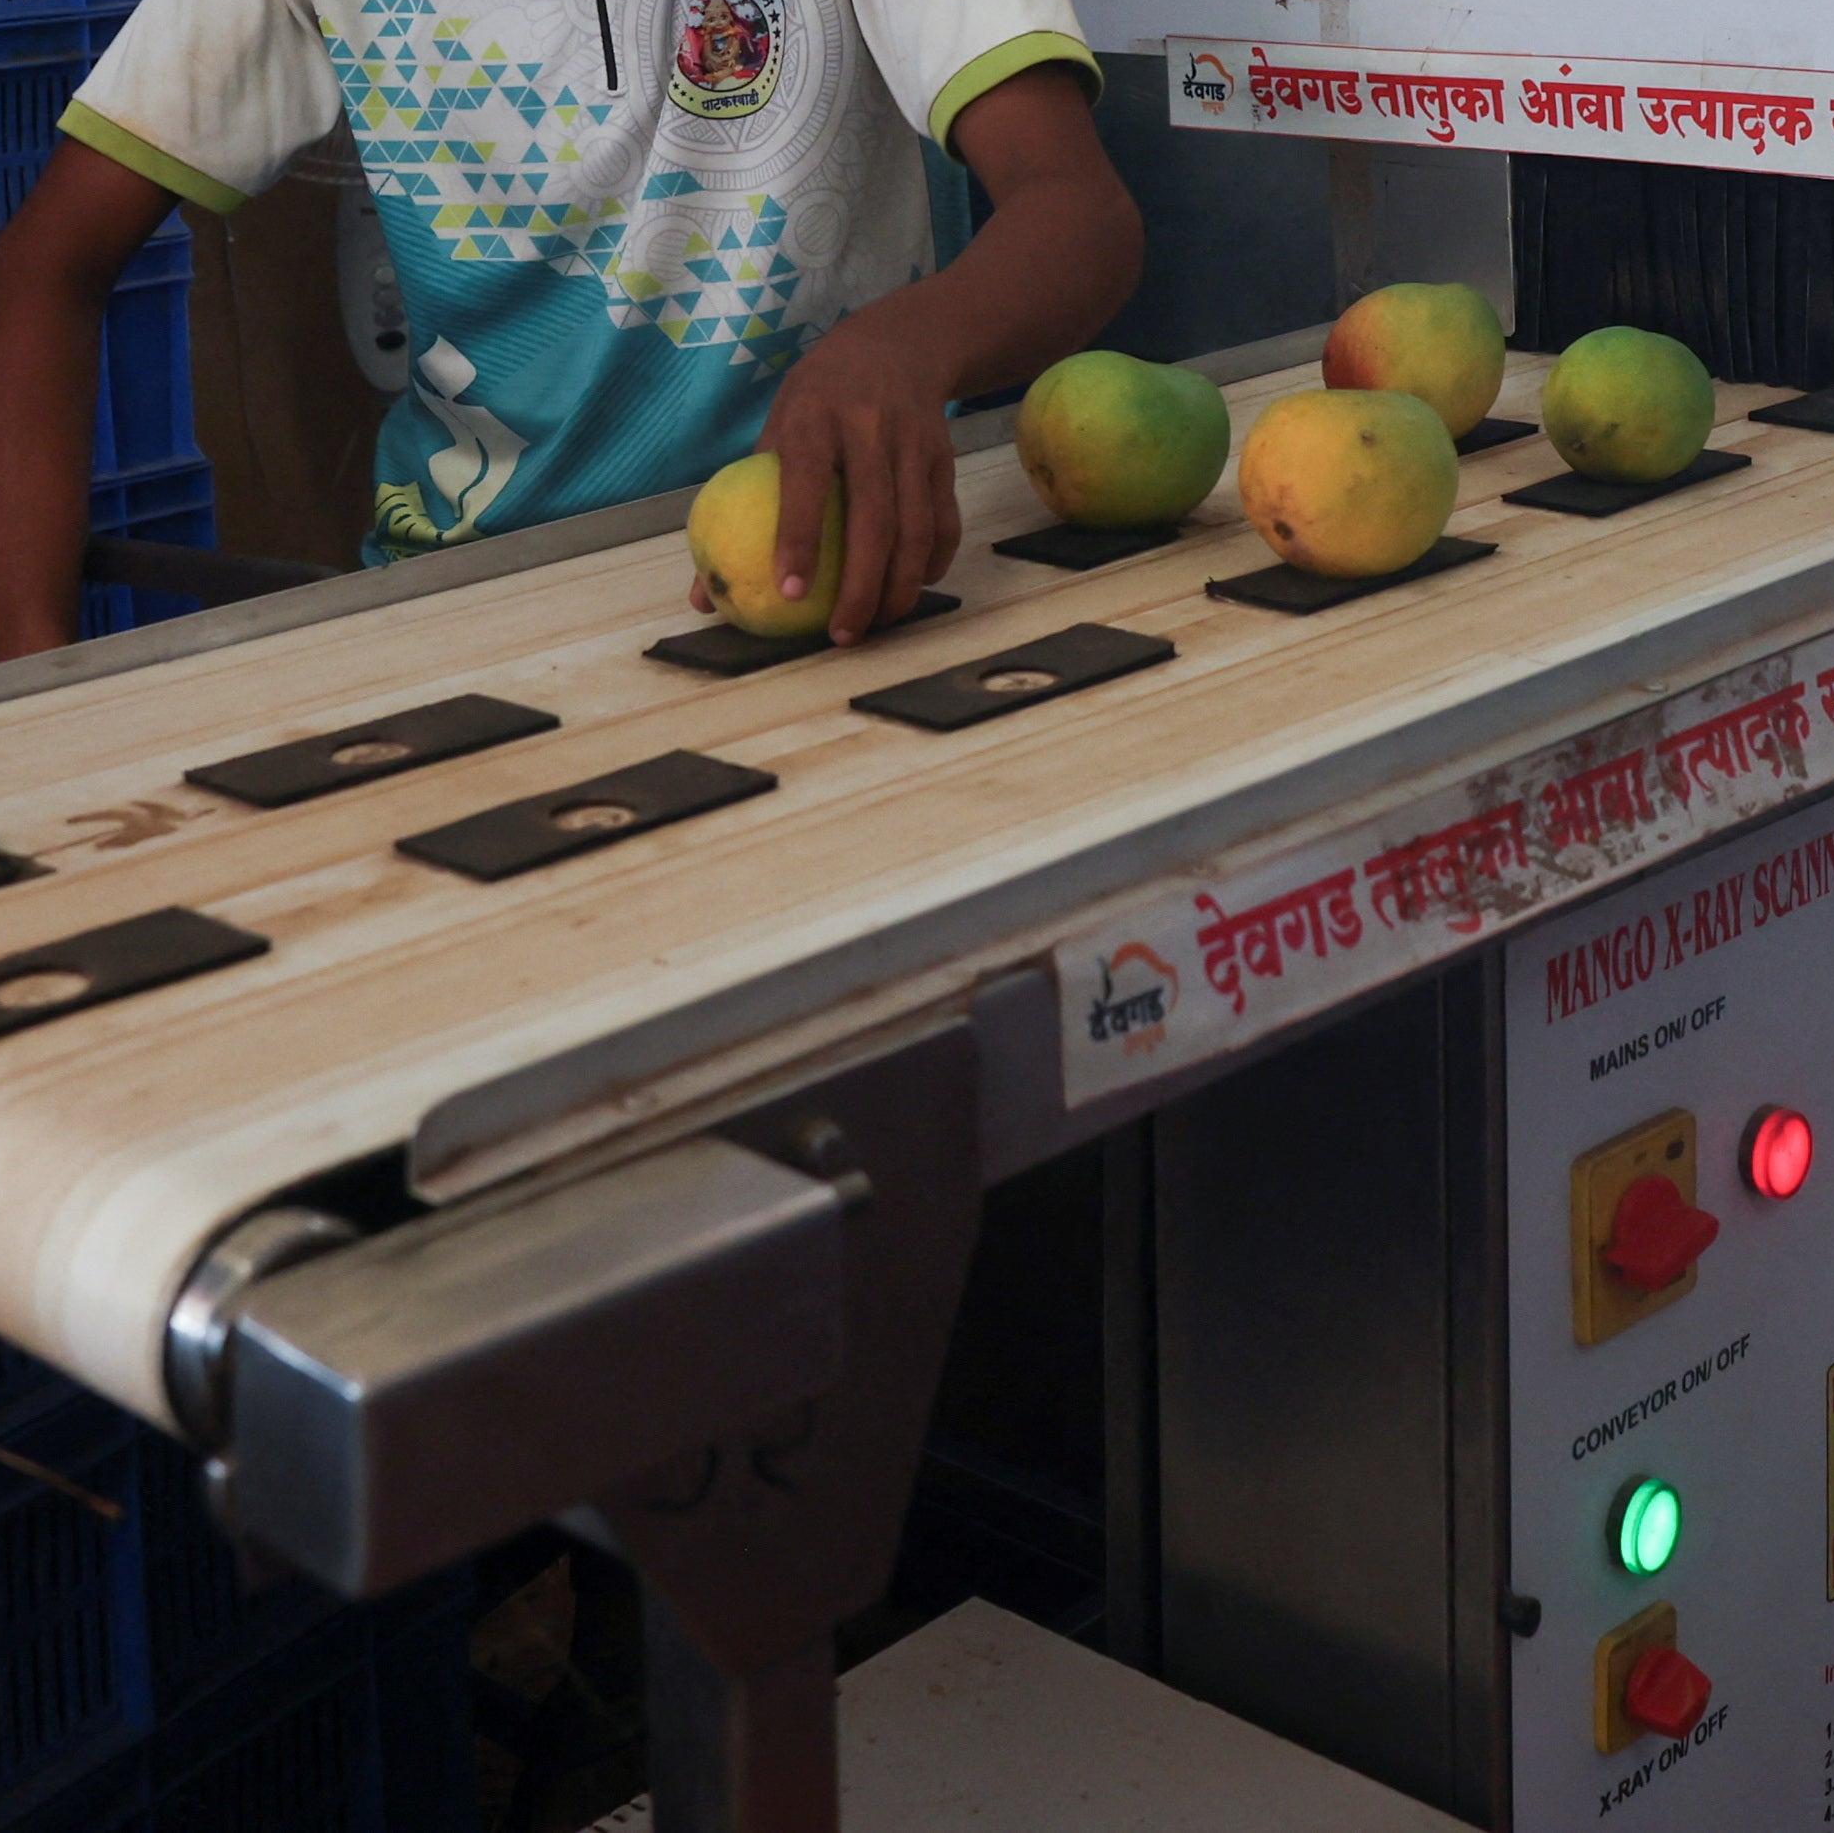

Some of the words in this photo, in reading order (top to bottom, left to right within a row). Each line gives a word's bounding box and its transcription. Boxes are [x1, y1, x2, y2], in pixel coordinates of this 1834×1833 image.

[1183, 74, 1226, 101] देवगड
[1248, 47, 1360, 118] देवगड
[1366, 72, 1504, 143] तालुका
[1518, 64, 1625, 133] आंबा
[1637, 86, 1814, 155] उत्पादक
[1194, 866, 1365, 1016] देवगड
[1364, 798, 1530, 933] तालुका
[1654, 681, 1810, 800] उत्पादक
[1545, 914, 1658, 1026] MANGO
[1663, 871, 1747, 972] X-RAY
[1589, 1033, 1649, 1082] MAINS
[1654, 1013, 1686, 1051] ON/
[1691, 995, 1726, 1032] OFF
[1571, 1379, 1677, 1461] CONVEYOR
[1681, 1357, 1713, 1395] ON/
[1717, 1332, 1751, 1371] OFF
[1598, 1758, 1655, 1818] X-RAY
[1694, 1704, 1729, 1746] OFF
